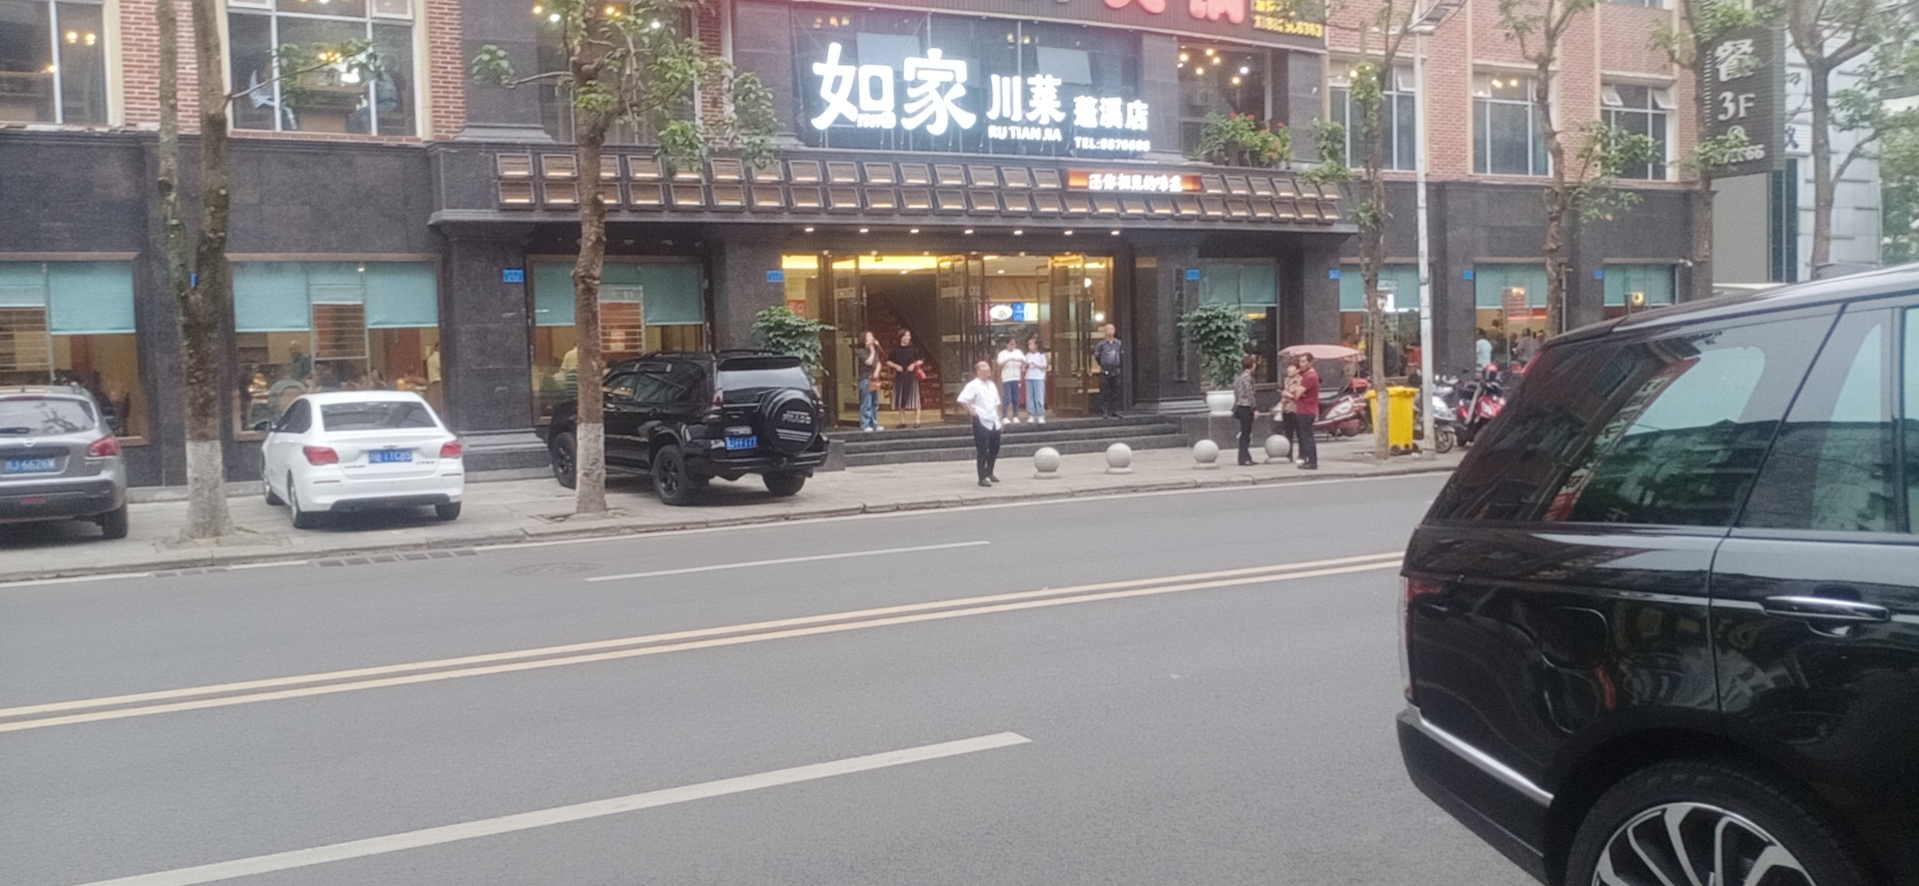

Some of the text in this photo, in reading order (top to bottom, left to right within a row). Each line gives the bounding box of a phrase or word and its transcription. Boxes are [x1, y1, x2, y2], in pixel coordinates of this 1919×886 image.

[811, 42, 1149, 136] 如家 川菜 蓬溪店
[1717, 91, 1756, 121] 3F
[988, 125, 1062, 142] RU TIAN JIA
